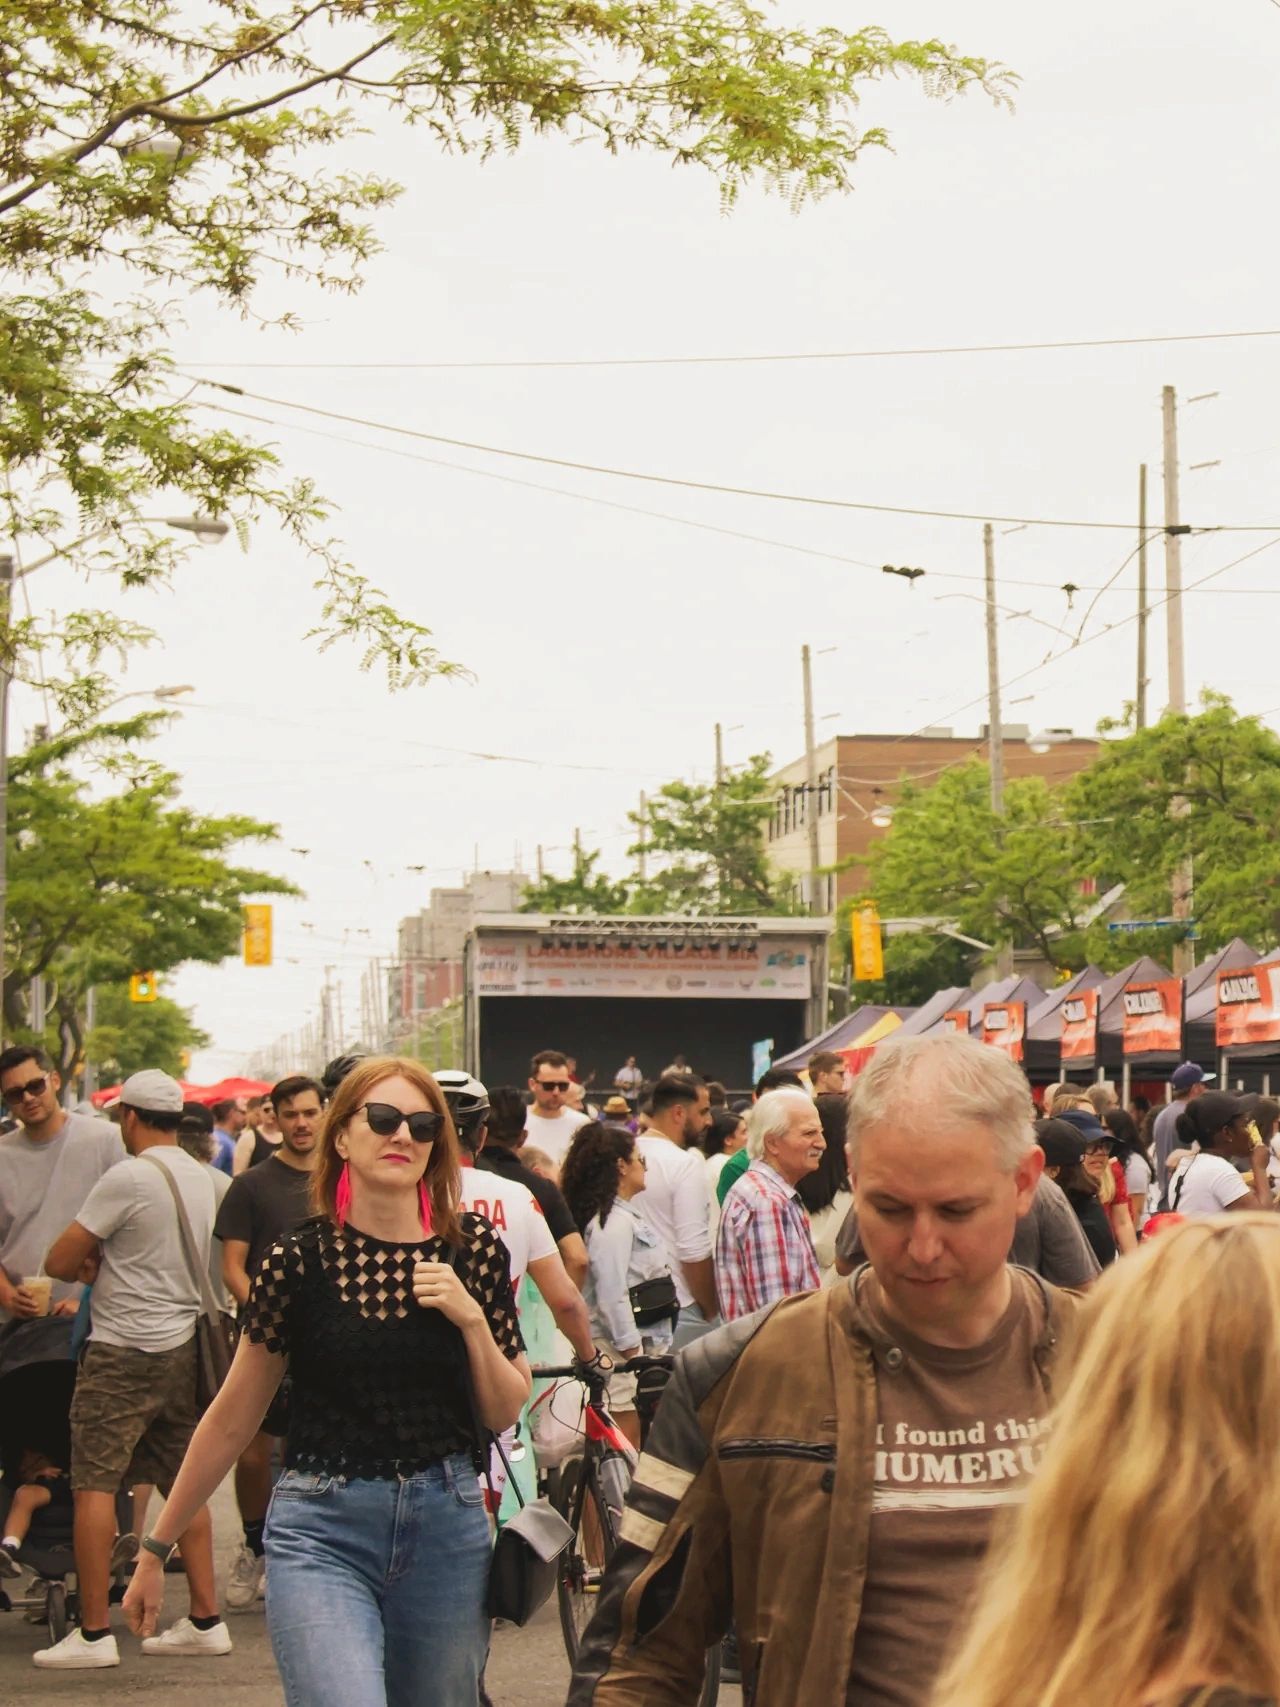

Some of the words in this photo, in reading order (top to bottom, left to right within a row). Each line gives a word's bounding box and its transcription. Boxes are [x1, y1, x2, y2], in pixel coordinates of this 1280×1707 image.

[875, 1424, 885, 1445] I
[896, 1420, 986, 1447] found
[874, 1442, 1052, 1484] UMERU
